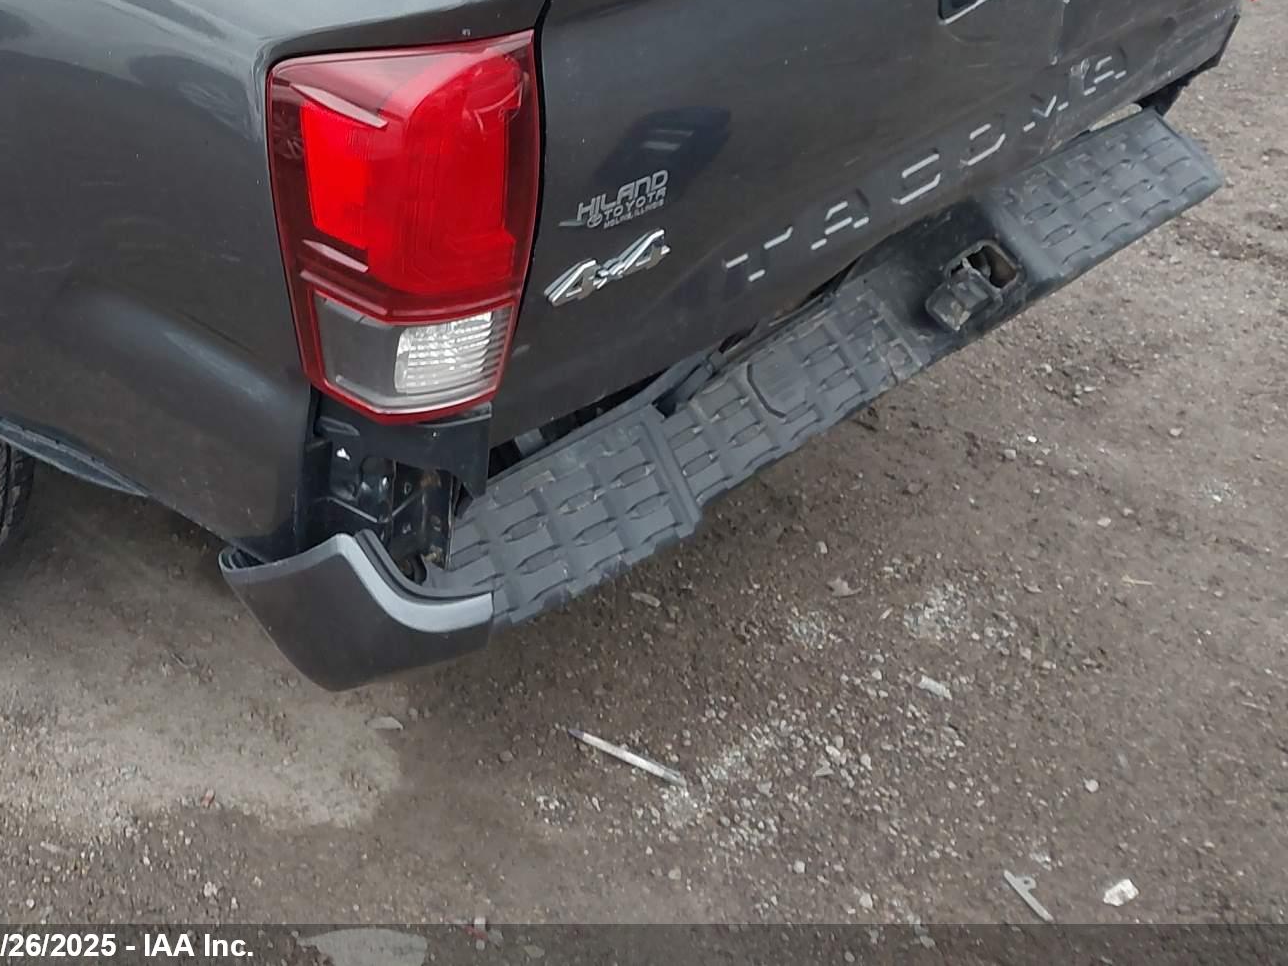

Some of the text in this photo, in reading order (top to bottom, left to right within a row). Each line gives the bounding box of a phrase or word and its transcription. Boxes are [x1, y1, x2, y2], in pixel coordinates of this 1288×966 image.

[724, 46, 1129, 284] TACOMA
[577, 170, 668, 221] HILAND
[603, 187, 667, 219] TOYOTA
